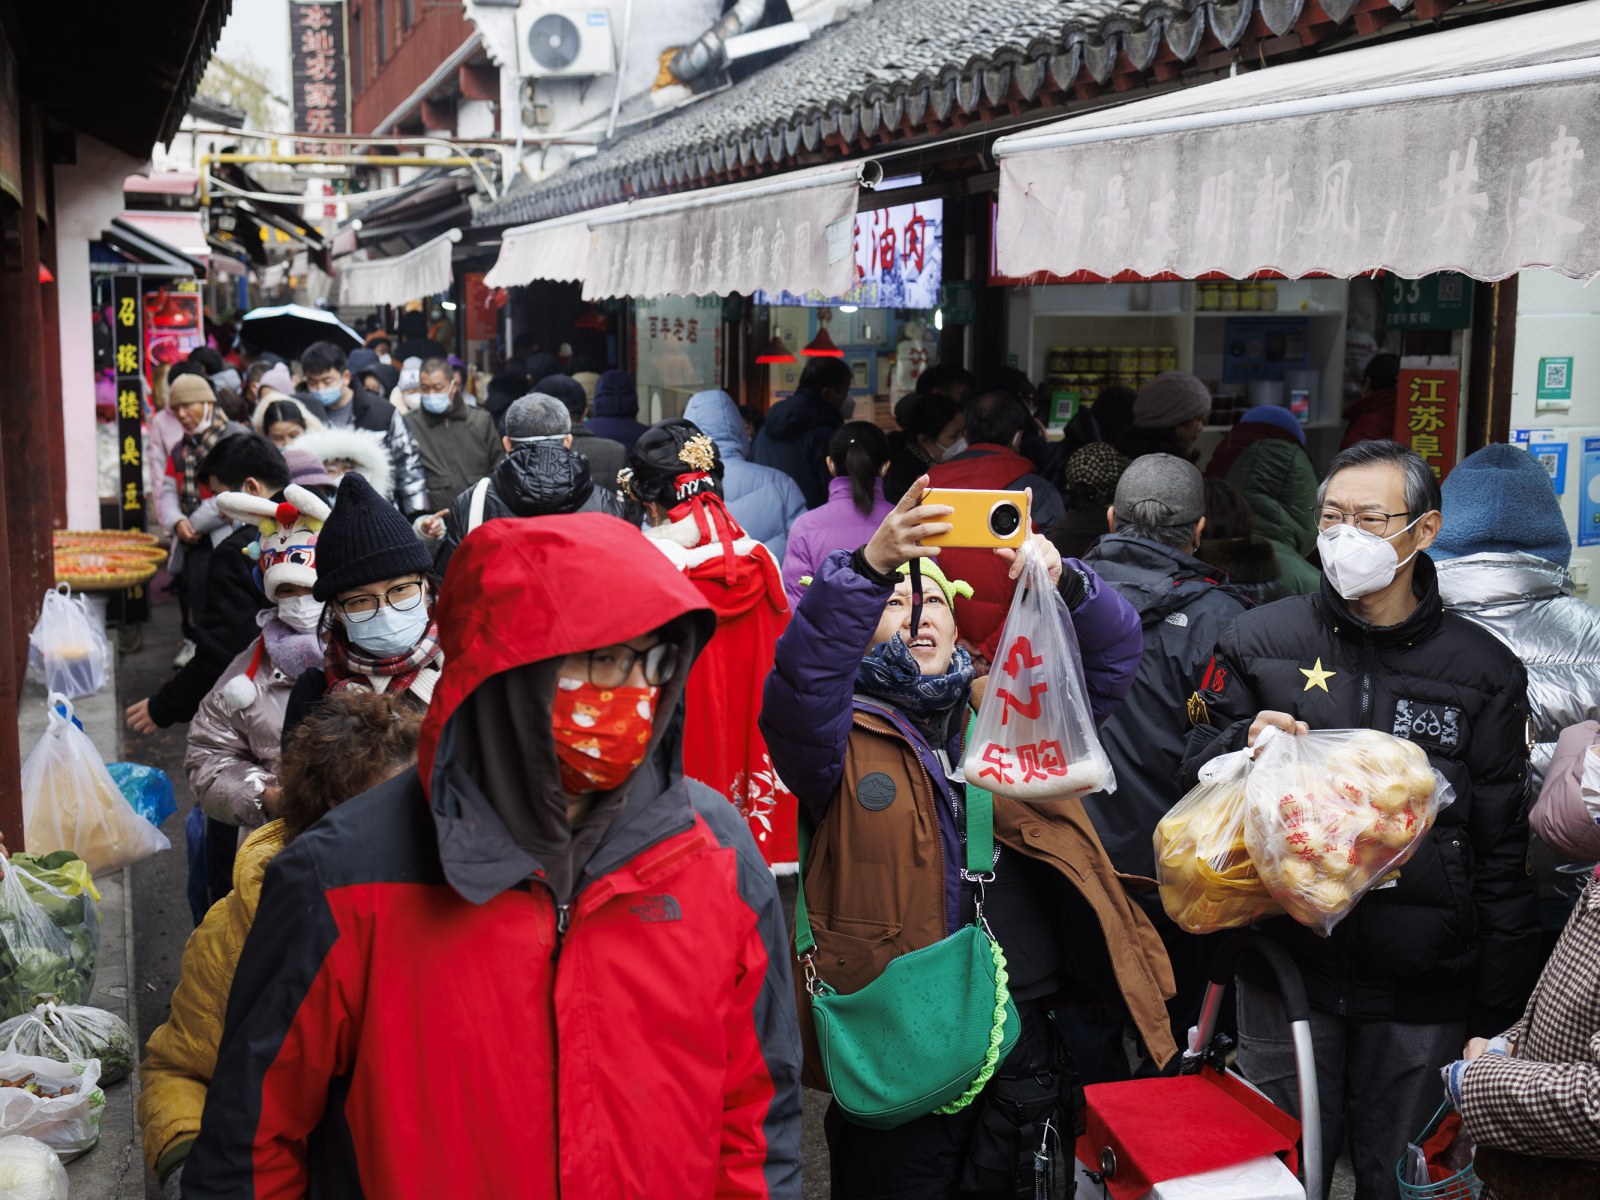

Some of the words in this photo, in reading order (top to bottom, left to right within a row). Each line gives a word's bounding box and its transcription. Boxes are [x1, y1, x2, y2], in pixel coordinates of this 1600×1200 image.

[299, 4, 338, 134] 本地农家乐
[854, 203, 926, 280] 油肉
[648, 316, 698, 343] 百年老店
[117, 297, 143, 534] 召稼楼臭豆
[1407, 377, 1446, 479] 江苏阜
